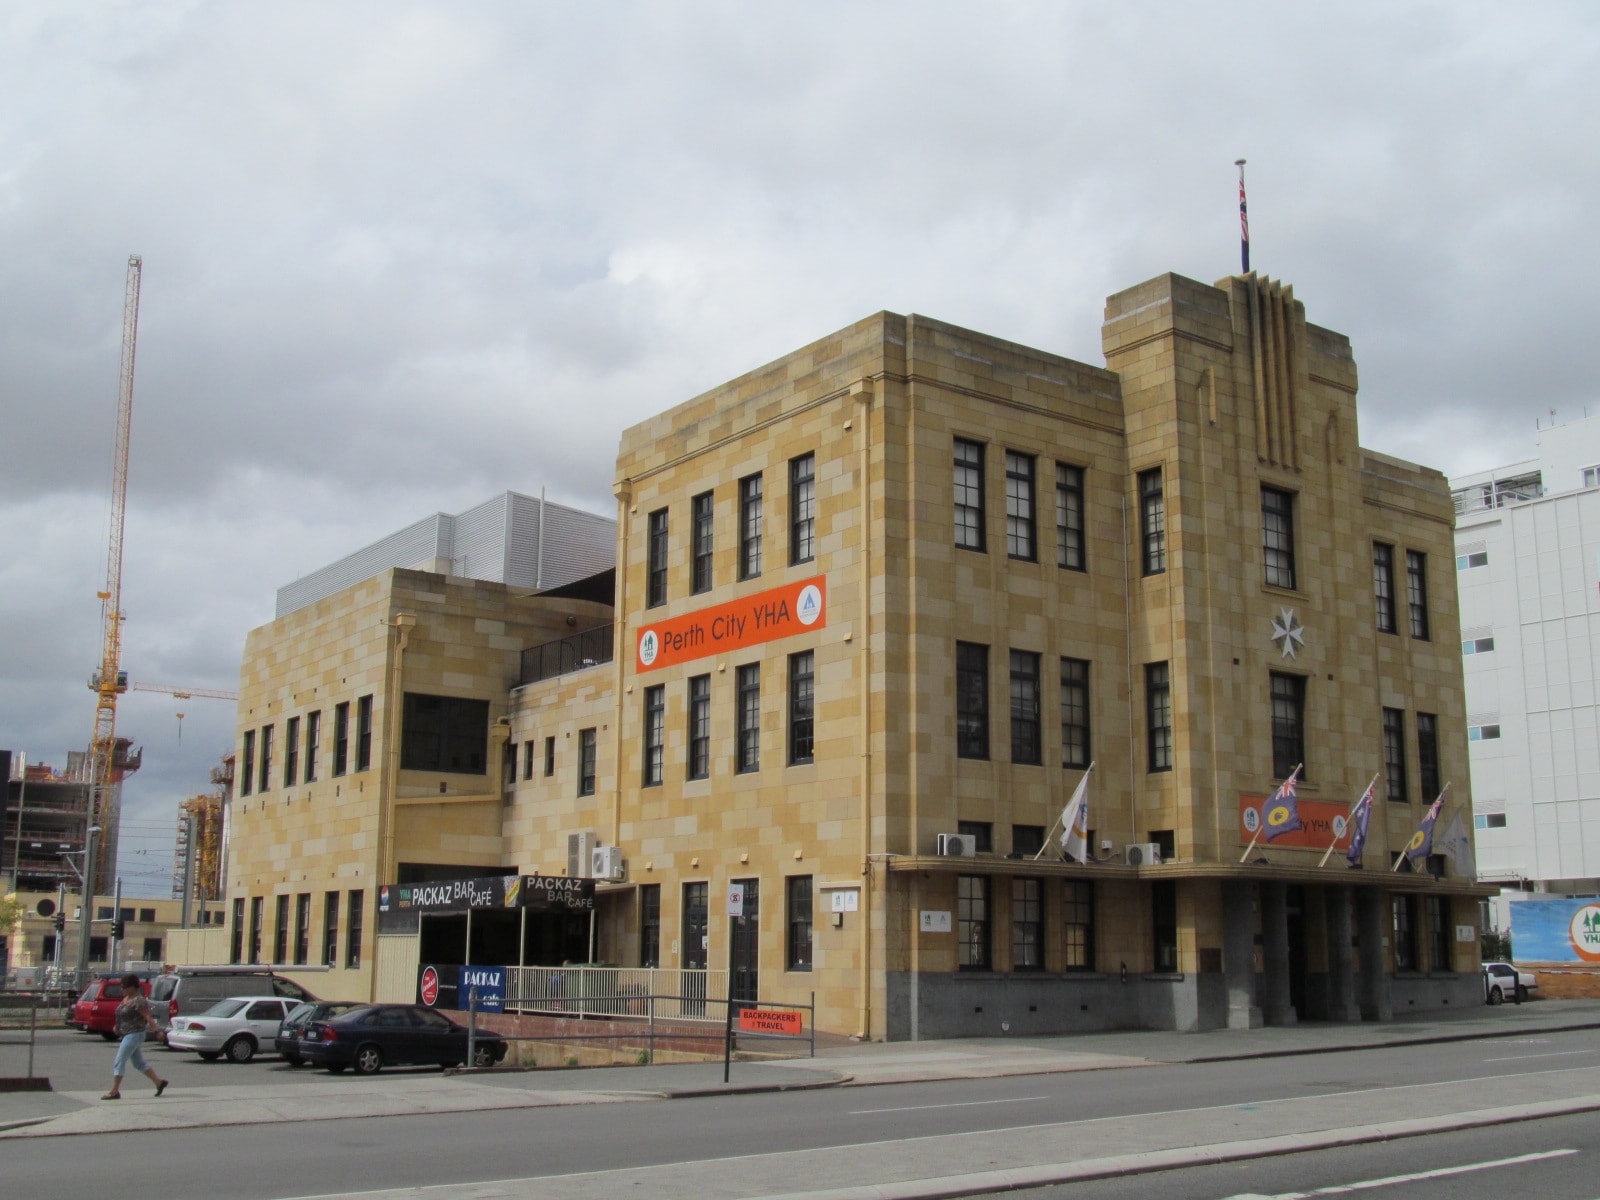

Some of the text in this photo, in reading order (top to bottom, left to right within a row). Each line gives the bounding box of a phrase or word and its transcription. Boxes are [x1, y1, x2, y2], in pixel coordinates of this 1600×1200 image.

[664, 600, 790, 653] Perth City YHA
[1311, 819, 1330, 832] YHA
[527, 877, 582, 891] PACKAZ
[412, 886, 452, 906] PACKAZ
[454, 881, 475, 899] BAR
[470, 887, 492, 906] CAFÉ
[547, 891, 593, 908] BAR CAFÉ
[1584, 934, 1600, 943] YH
[464, 971, 500, 987] PACKAZ
[743, 1011, 796, 1021] BACKPACKERS
[757, 1021, 784, 1030] TRAVEL
